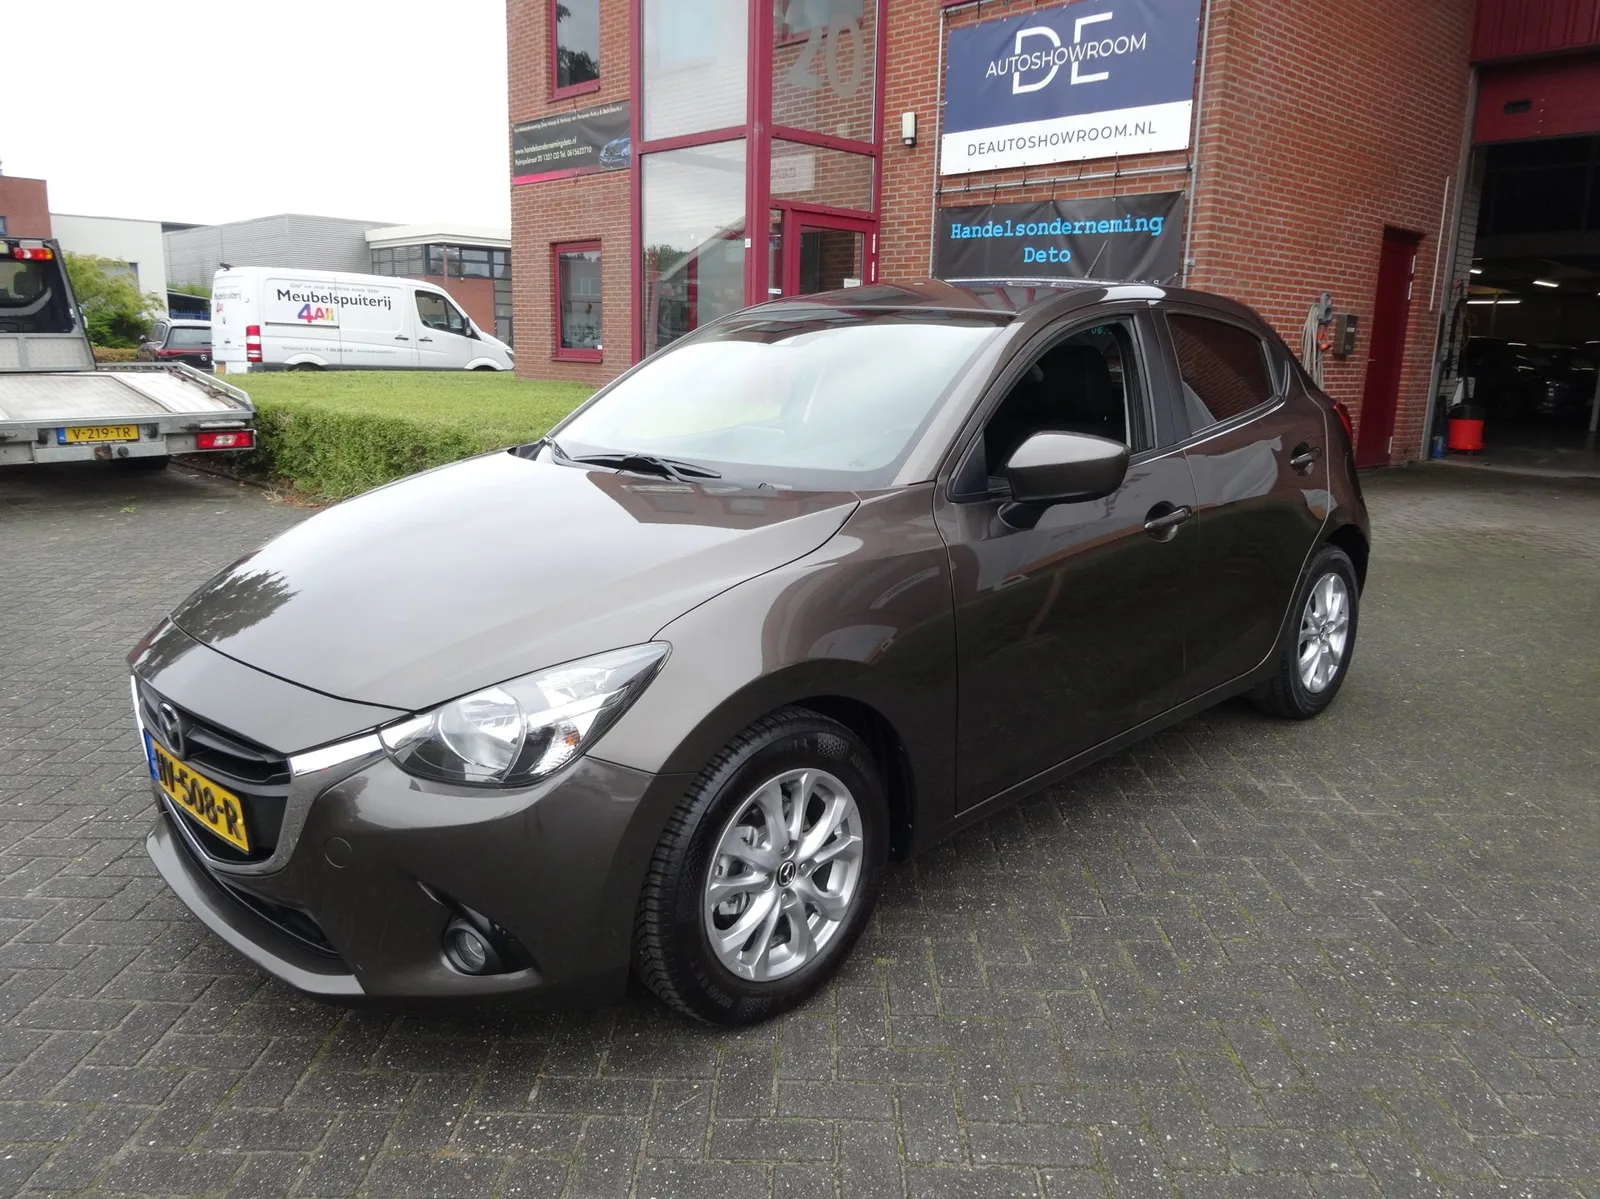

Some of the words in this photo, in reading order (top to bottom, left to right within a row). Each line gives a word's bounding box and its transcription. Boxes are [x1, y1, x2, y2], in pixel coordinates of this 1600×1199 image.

[986, 32, 1148, 78] AUTOSHOWROOM
[1012, 11, 1113, 95] DE
[967, 120, 1157, 156] DEAUTOSHOWROOM.NL
[537, 155, 543, 163] 20
[552, 151, 560, 159] CG
[559, 150, 567, 158] Tel.
[950, 215, 1165, 239] Handelsonderneming
[1023, 247, 1071, 263] Deto
[277, 288, 392, 310] Meubelspuiterij
[72, 427, 132, 440] V-219-TR
